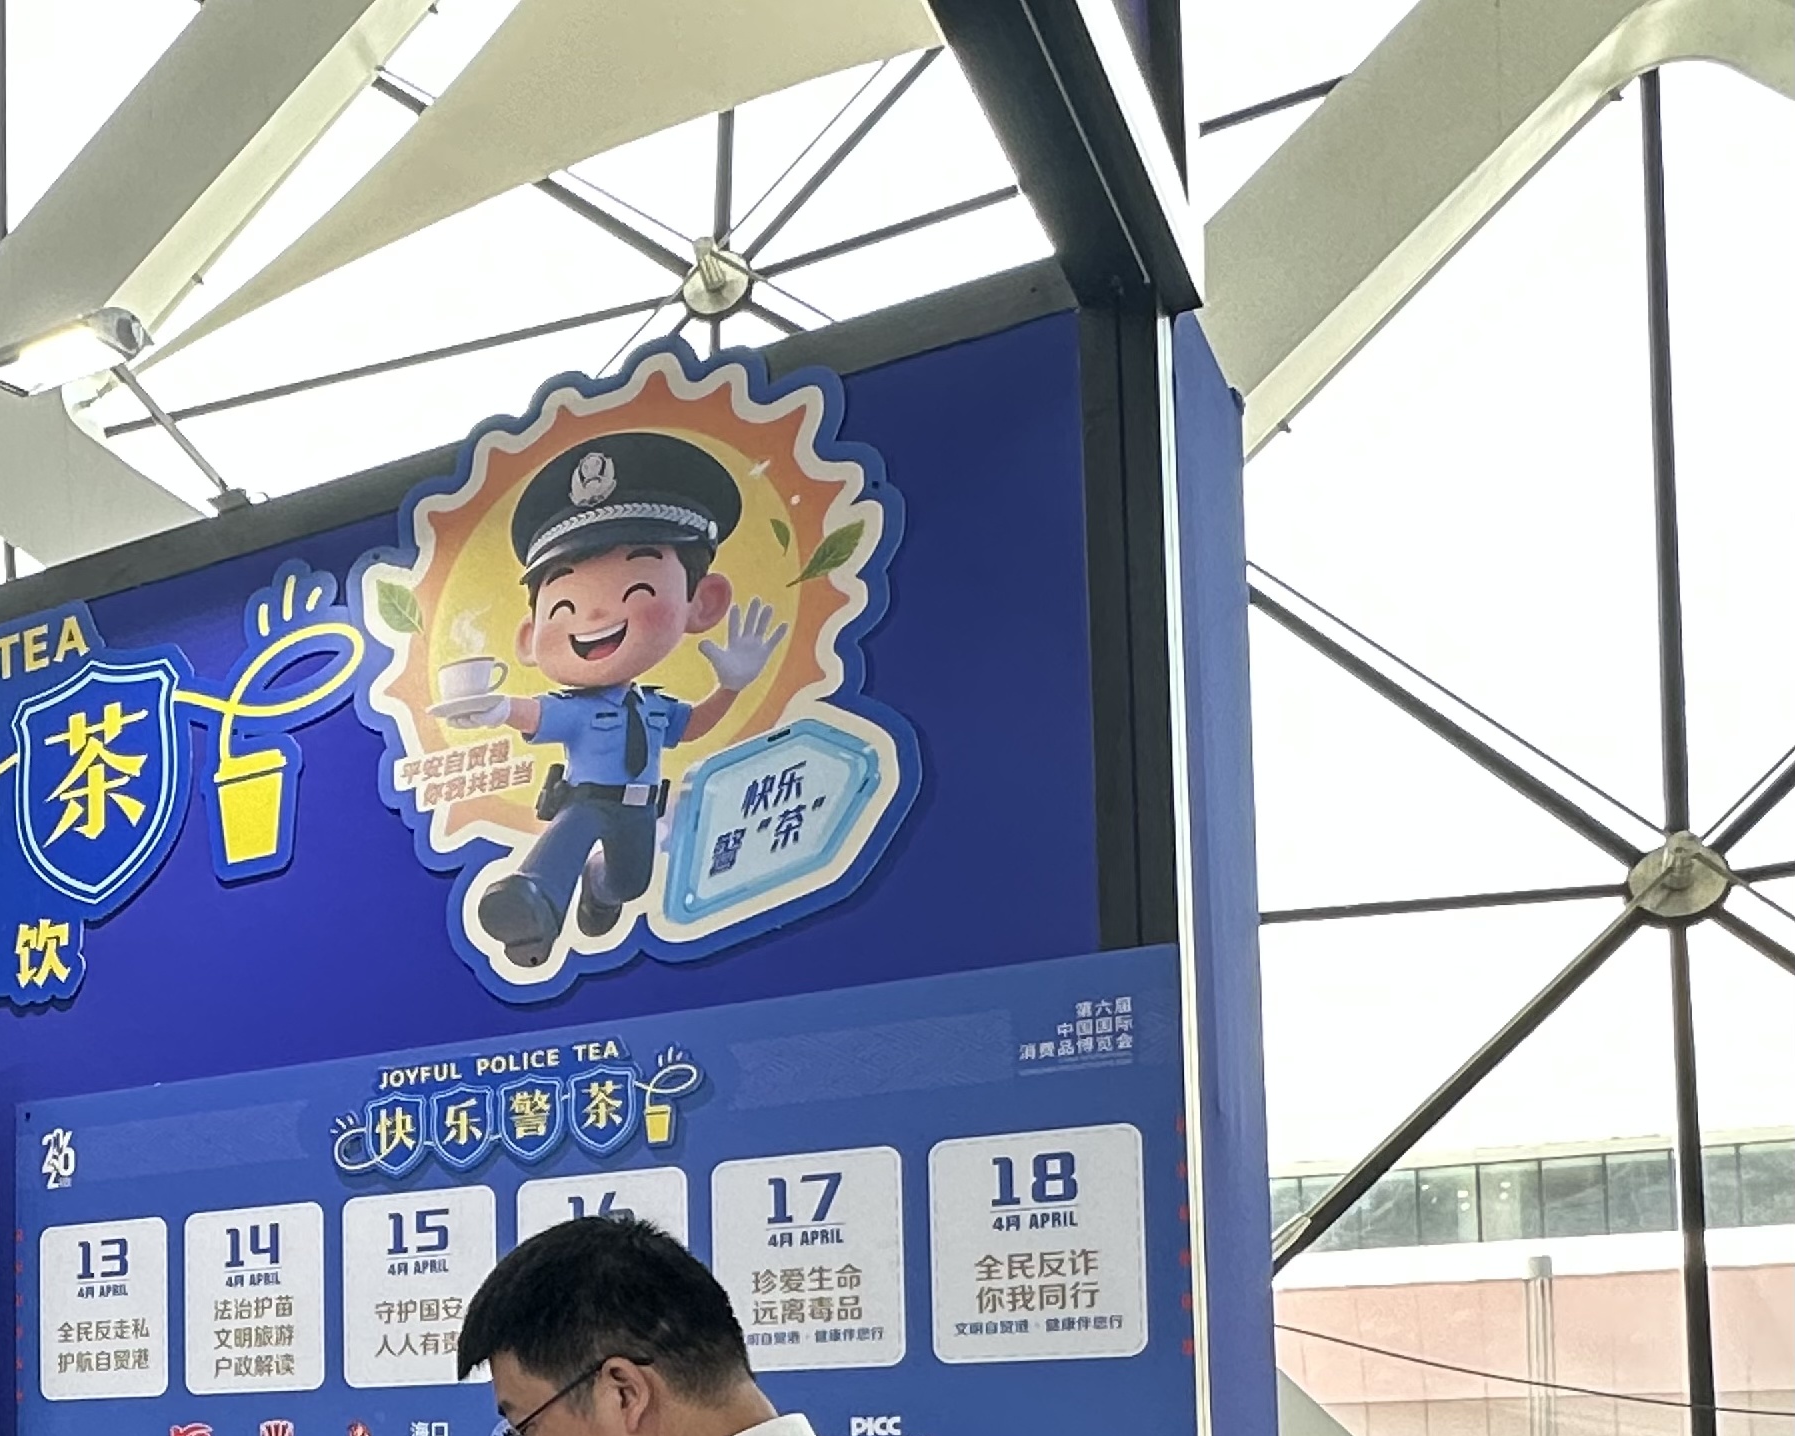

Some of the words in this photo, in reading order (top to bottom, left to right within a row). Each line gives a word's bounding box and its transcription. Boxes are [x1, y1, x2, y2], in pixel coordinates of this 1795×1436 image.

[741, 760, 807, 819] 快乐
[378, 1060, 462, 1090] JOYFUL
[475, 1047, 560, 1076] POLICE
[573, 1040, 620, 1062] TEA
[374, 1080, 624, 1153] 快乐警茶
[990, 1150, 1078, 1208] 18
[766, 1171, 843, 1225] 17
[387, 1208, 450, 1256] 15
[992, 1214, 1021, 1232] 4月
[1029, 1209, 1079, 1231] APRIL
[224, 1222, 281, 1268] 14
[767, 1231, 793, 1249] 4月
[800, 1228, 845, 1247] APRIL
[76, 1237, 130, 1280] 13
[387, 1261, 409, 1277] 4月
[413, 1258, 449, 1275] APRIL
[973, 1248, 1101, 1282] 全民反诈
[98, 1283, 129, 1298] APRIL
[248, 1271, 282, 1287] APRIL
[751, 1262, 863, 1296] 珍爱生命
[213, 1294, 295, 1322] 法治护苗
[374, 1296, 464, 1325] 守护国安
[751, 1293, 864, 1327] 远离毒品
[975, 1280, 1101, 1315] 你我同行
[57, 1318, 151, 1343] 全民反走私
[213, 1323, 295, 1351] 文明旅游
[57, 1348, 150, 1375] 护航自贸港
[213, 1352, 296, 1380] 户政解读
[850, 1416, 901, 1436] PICC
